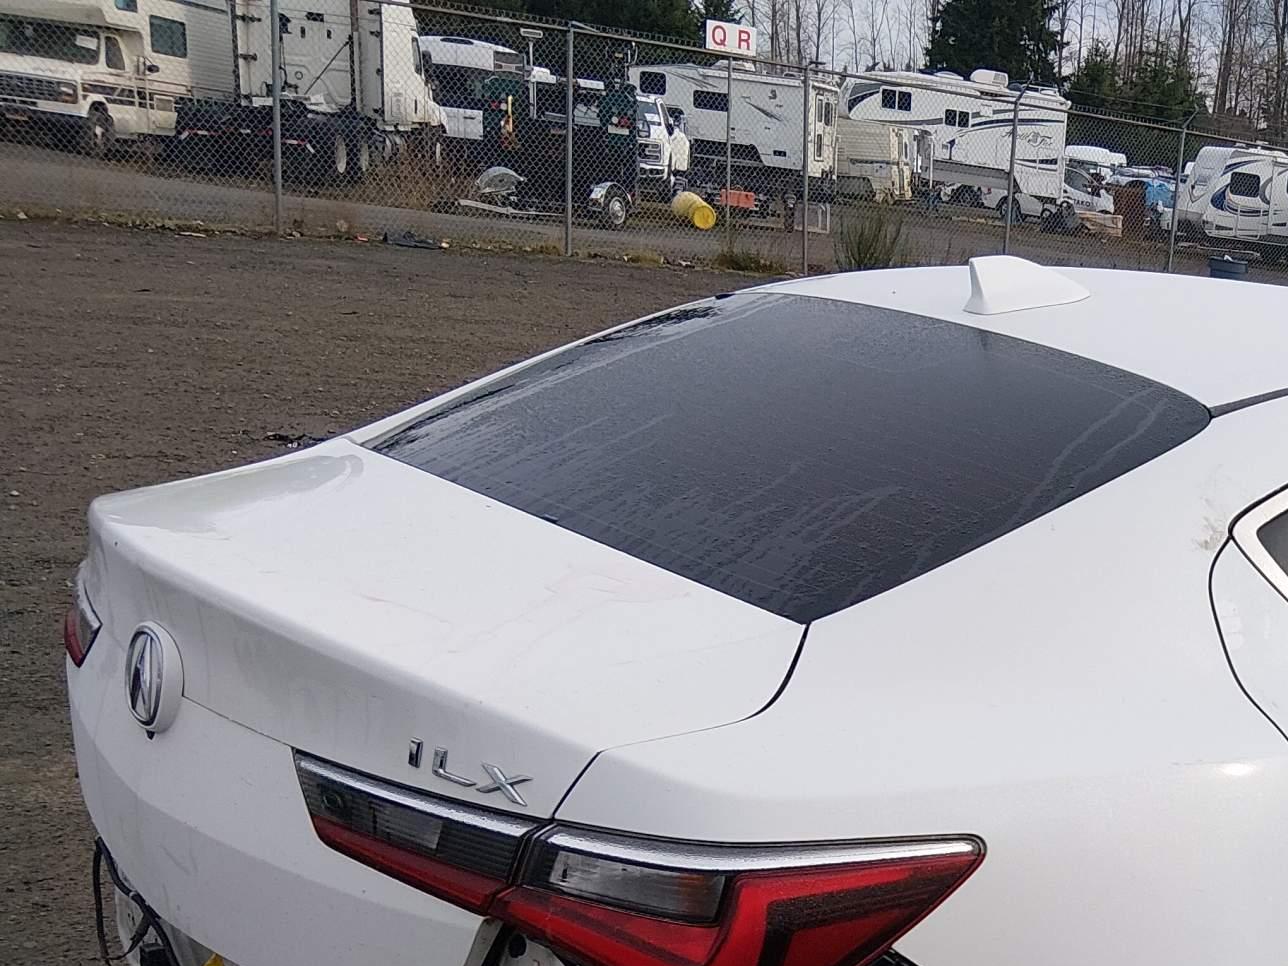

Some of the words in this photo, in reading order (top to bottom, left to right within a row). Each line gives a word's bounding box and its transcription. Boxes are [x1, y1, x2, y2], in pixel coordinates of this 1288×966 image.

[711, 24, 728, 47] Q
[737, 29, 751, 51] R
[407, 736, 534, 807] ILX
